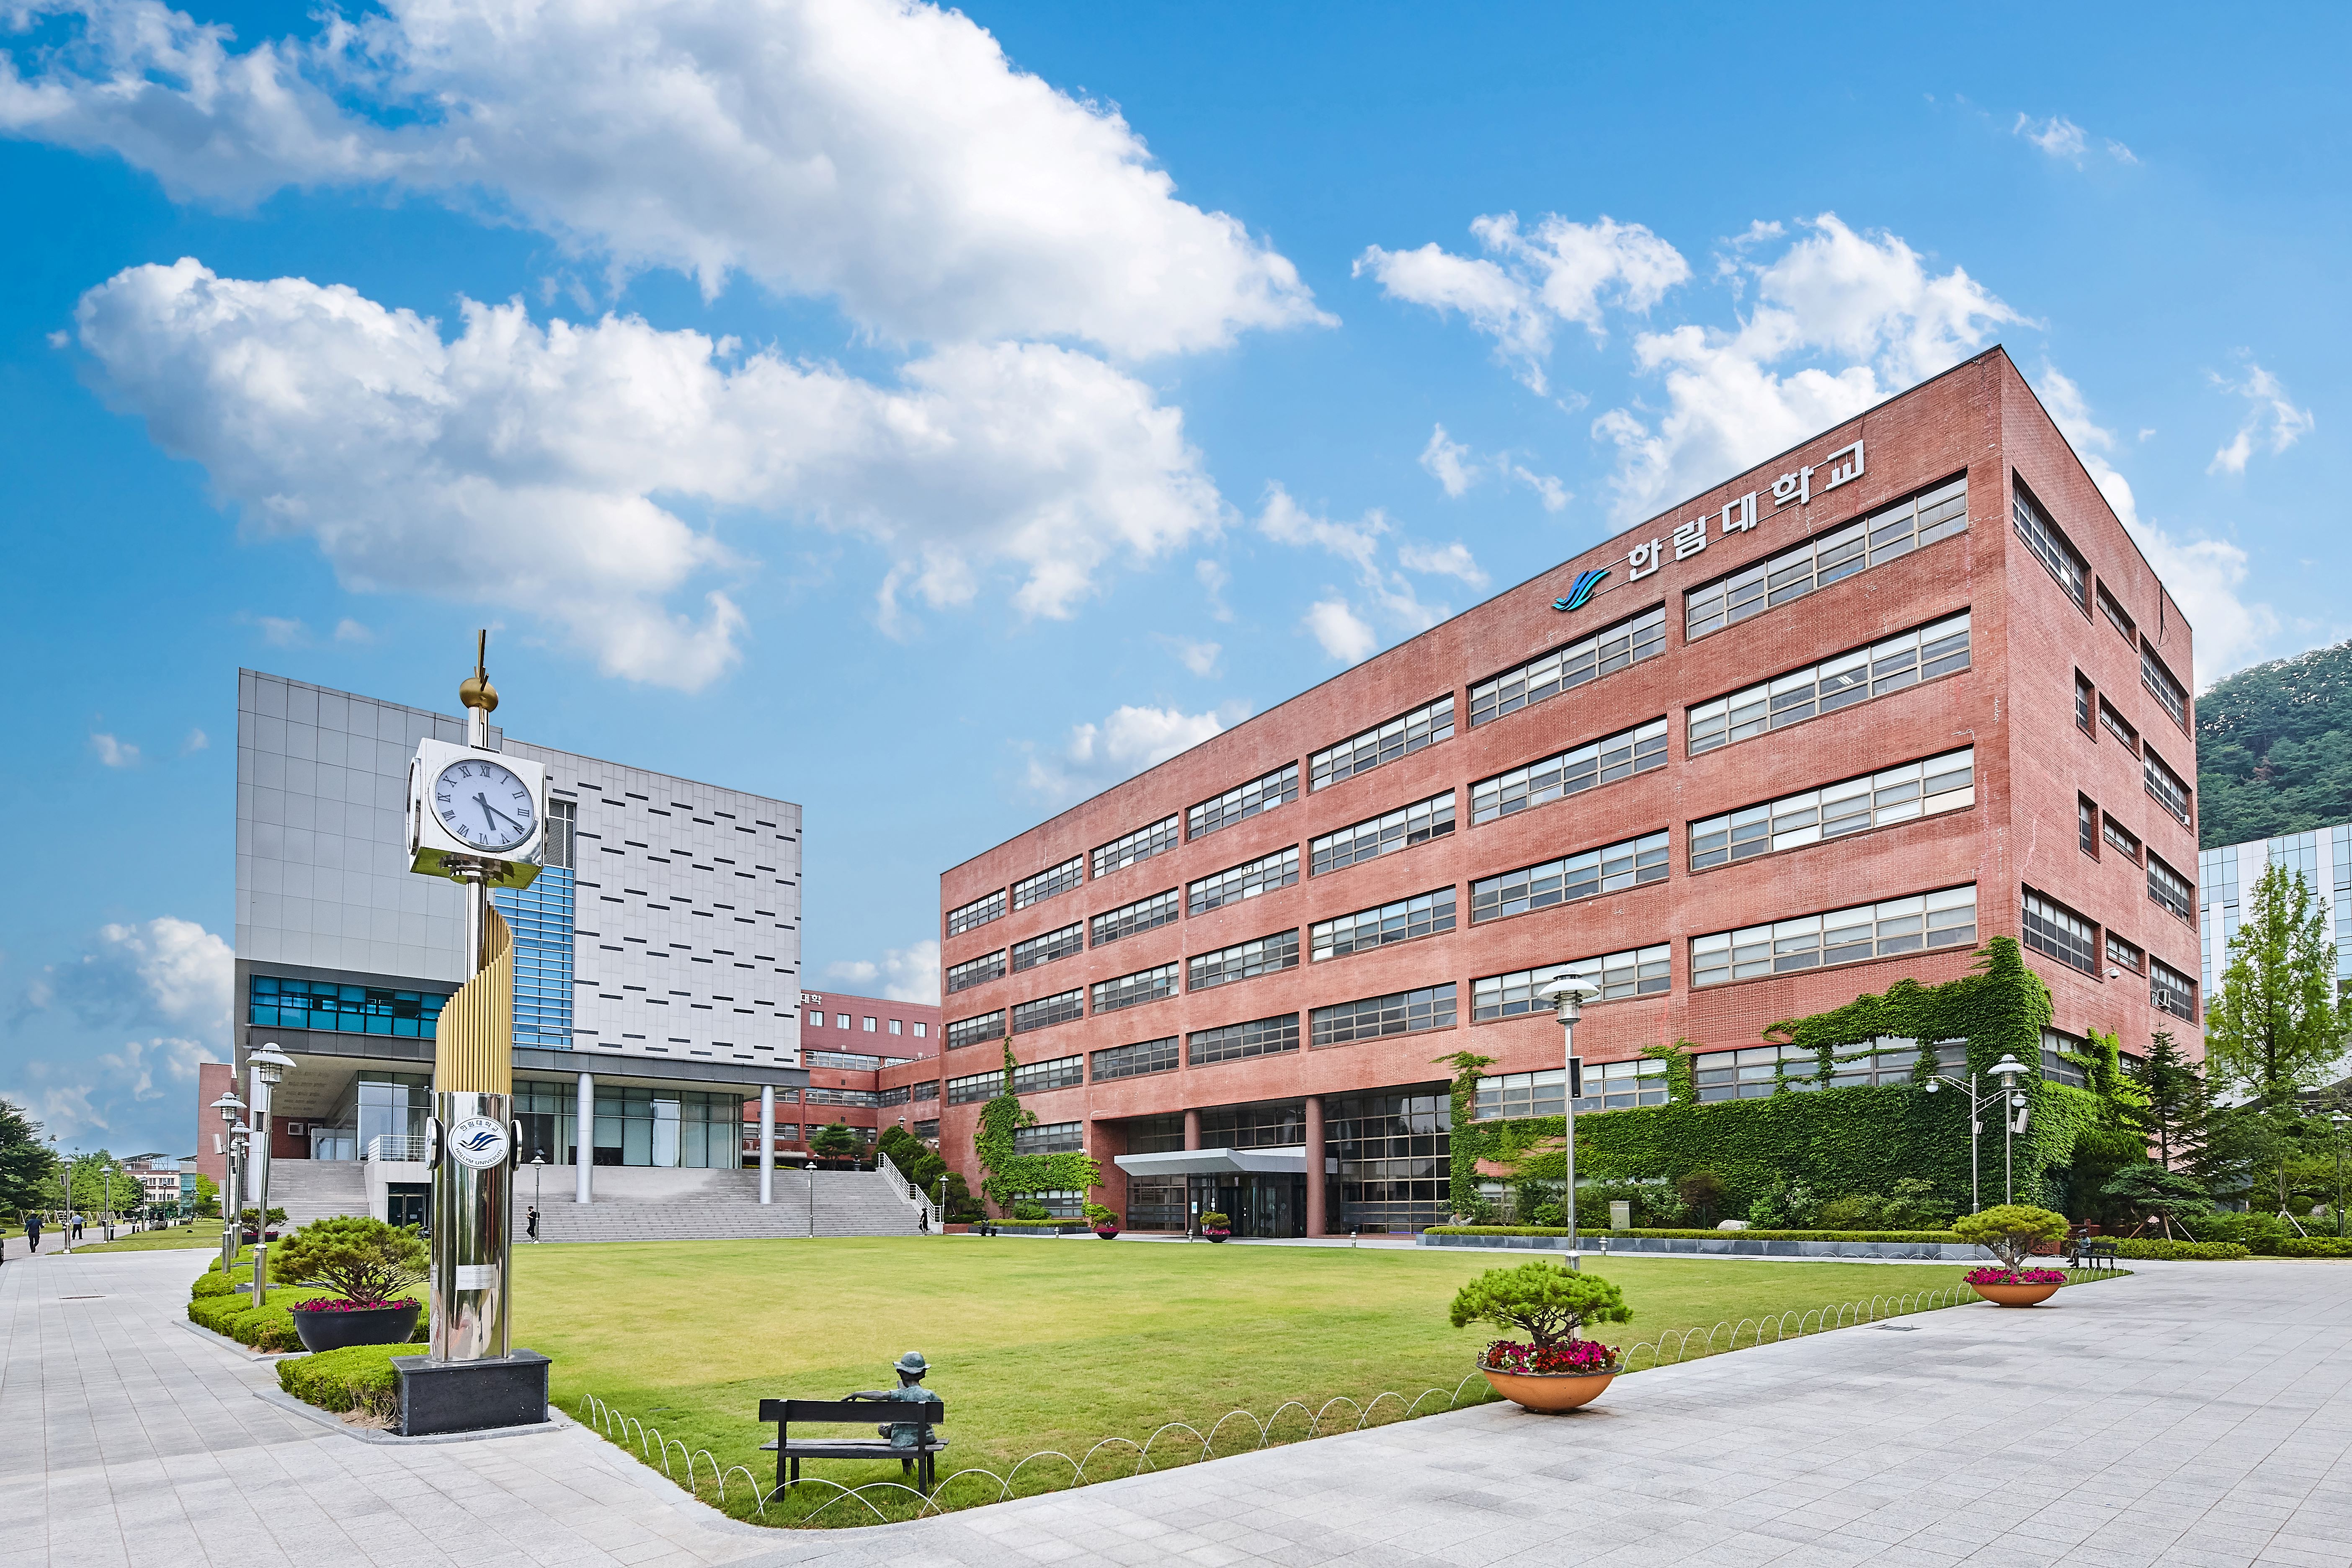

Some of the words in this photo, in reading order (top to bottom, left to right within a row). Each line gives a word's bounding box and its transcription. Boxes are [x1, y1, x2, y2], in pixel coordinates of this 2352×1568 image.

[1628, 439, 1865, 582] 한림대학교
[458, 766, 472, 778] XI
[480, 765, 490, 777] XII
[443, 775, 457, 787] X
[500, 775, 509, 784] I
[438, 792, 451, 803] IX
[512, 791, 525, 799] II
[441, 810, 456, 822] VIII
[518, 808, 529, 817] III
[456, 824, 469, 837] VII
[479, 833, 489, 845] VI
[500, 833, 511, 844] V
[460, 1120, 498, 1132] 한림대학교
[455, 1148, 473, 1164] HALLYM
[475, 1149, 503, 1165] UNIVERSITY
